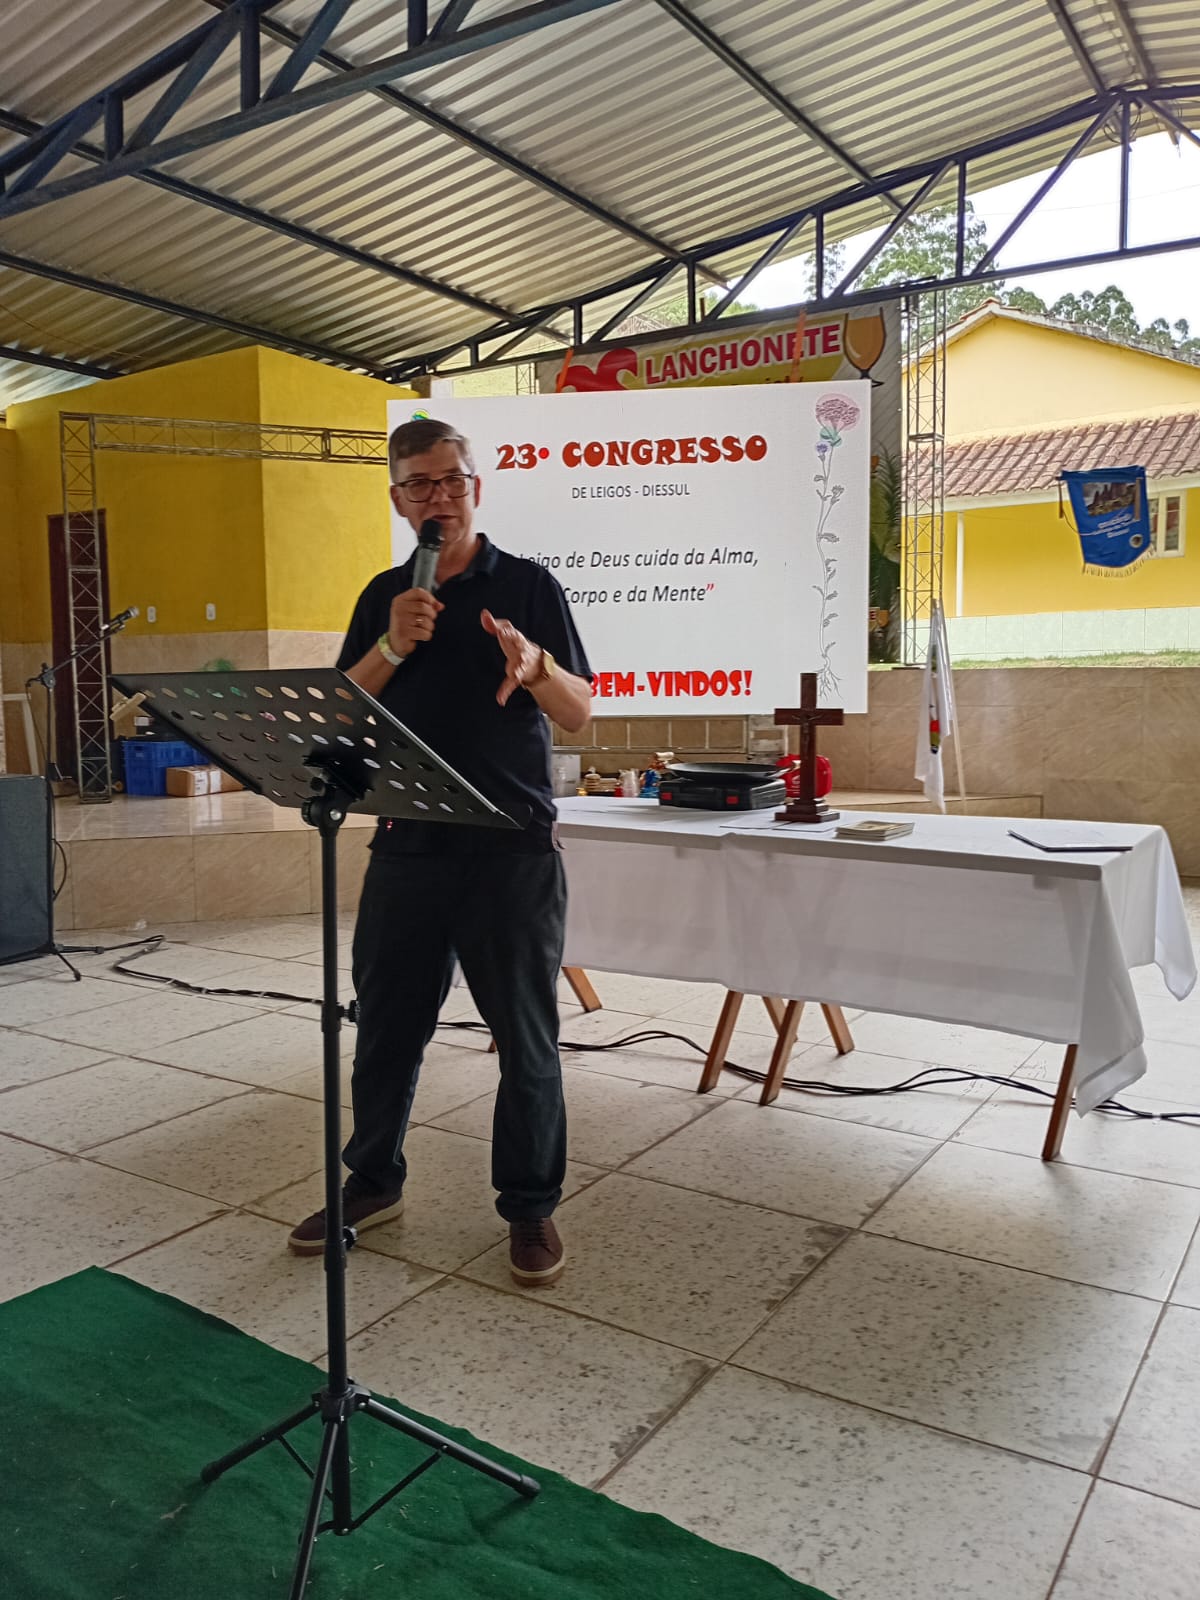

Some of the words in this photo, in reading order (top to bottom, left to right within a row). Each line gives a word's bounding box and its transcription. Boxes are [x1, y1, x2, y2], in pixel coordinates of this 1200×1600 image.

[645, 324, 841, 385] LANCHONETE
[562, 435, 767, 468] CONGRESSO
[571, 486, 588, 499] DE
[590, 485, 632, 499] LEIGOS
[642, 483, 691, 497] DIESSUL
[565, 551, 586, 569] de
[590, 550, 631, 568] Deus
[634, 548, 680, 567] cuida
[684, 547, 705, 565] da
[708, 546, 759, 568] Alma,
[612, 590, 623, 603] e
[626, 585, 648, 603] da
